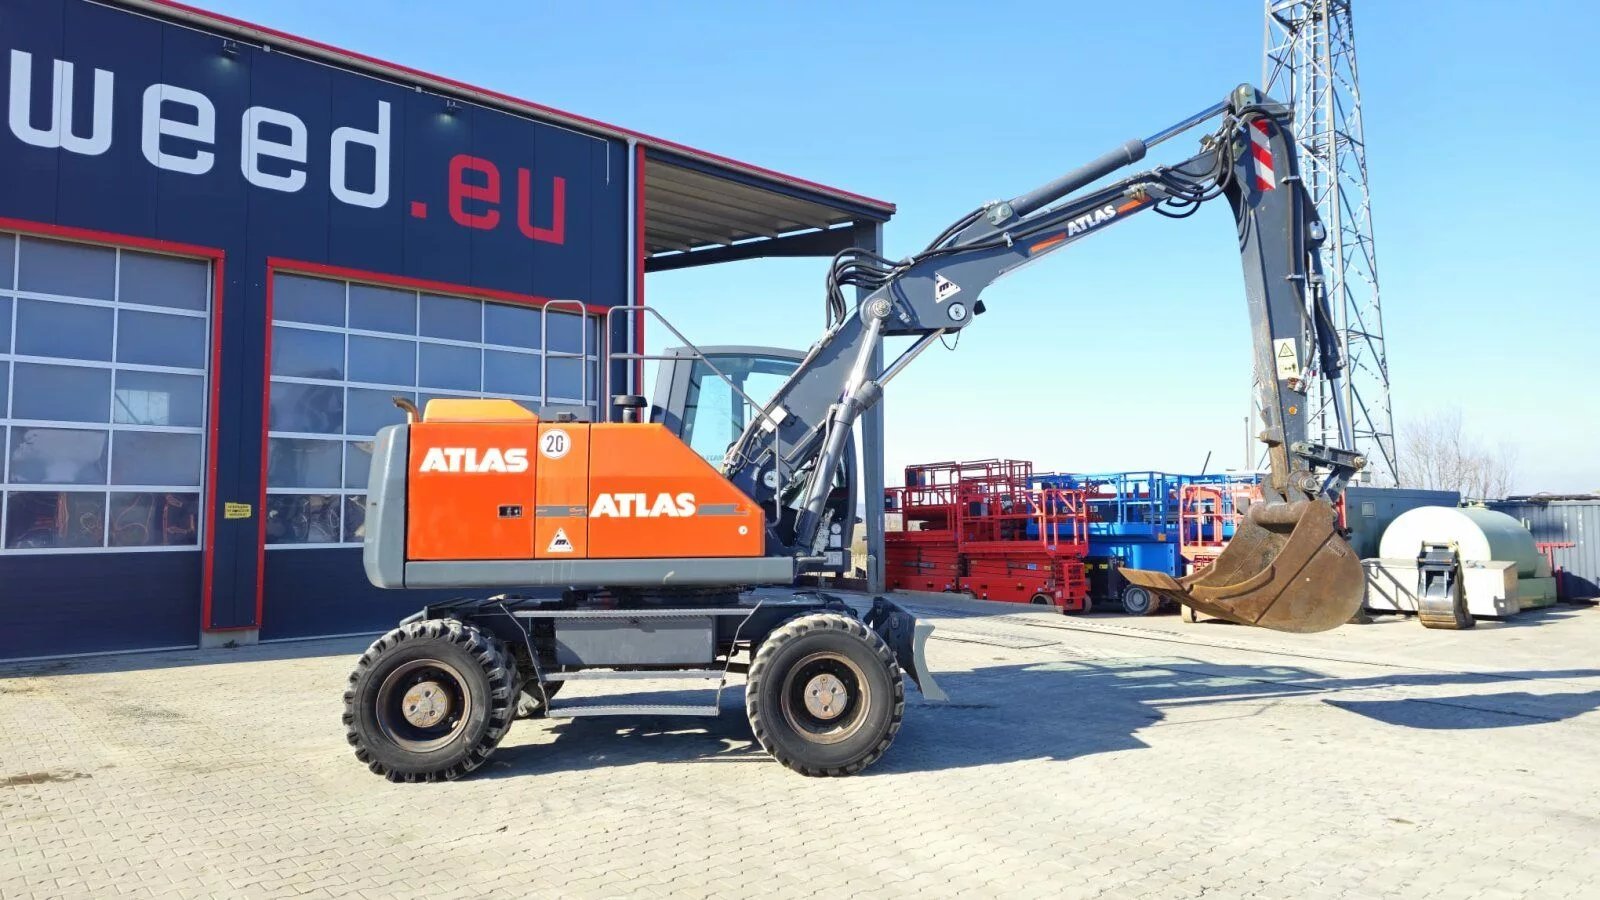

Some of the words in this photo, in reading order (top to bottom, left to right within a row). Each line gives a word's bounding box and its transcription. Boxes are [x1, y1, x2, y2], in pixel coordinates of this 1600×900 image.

[9, 49, 565, 244] weed.eu
[1067, 204, 1117, 237] ATLAS
[546, 434, 564, 453] 20
[419, 447, 529, 473] ATLAS
[588, 492, 696, 518] ATLAS
